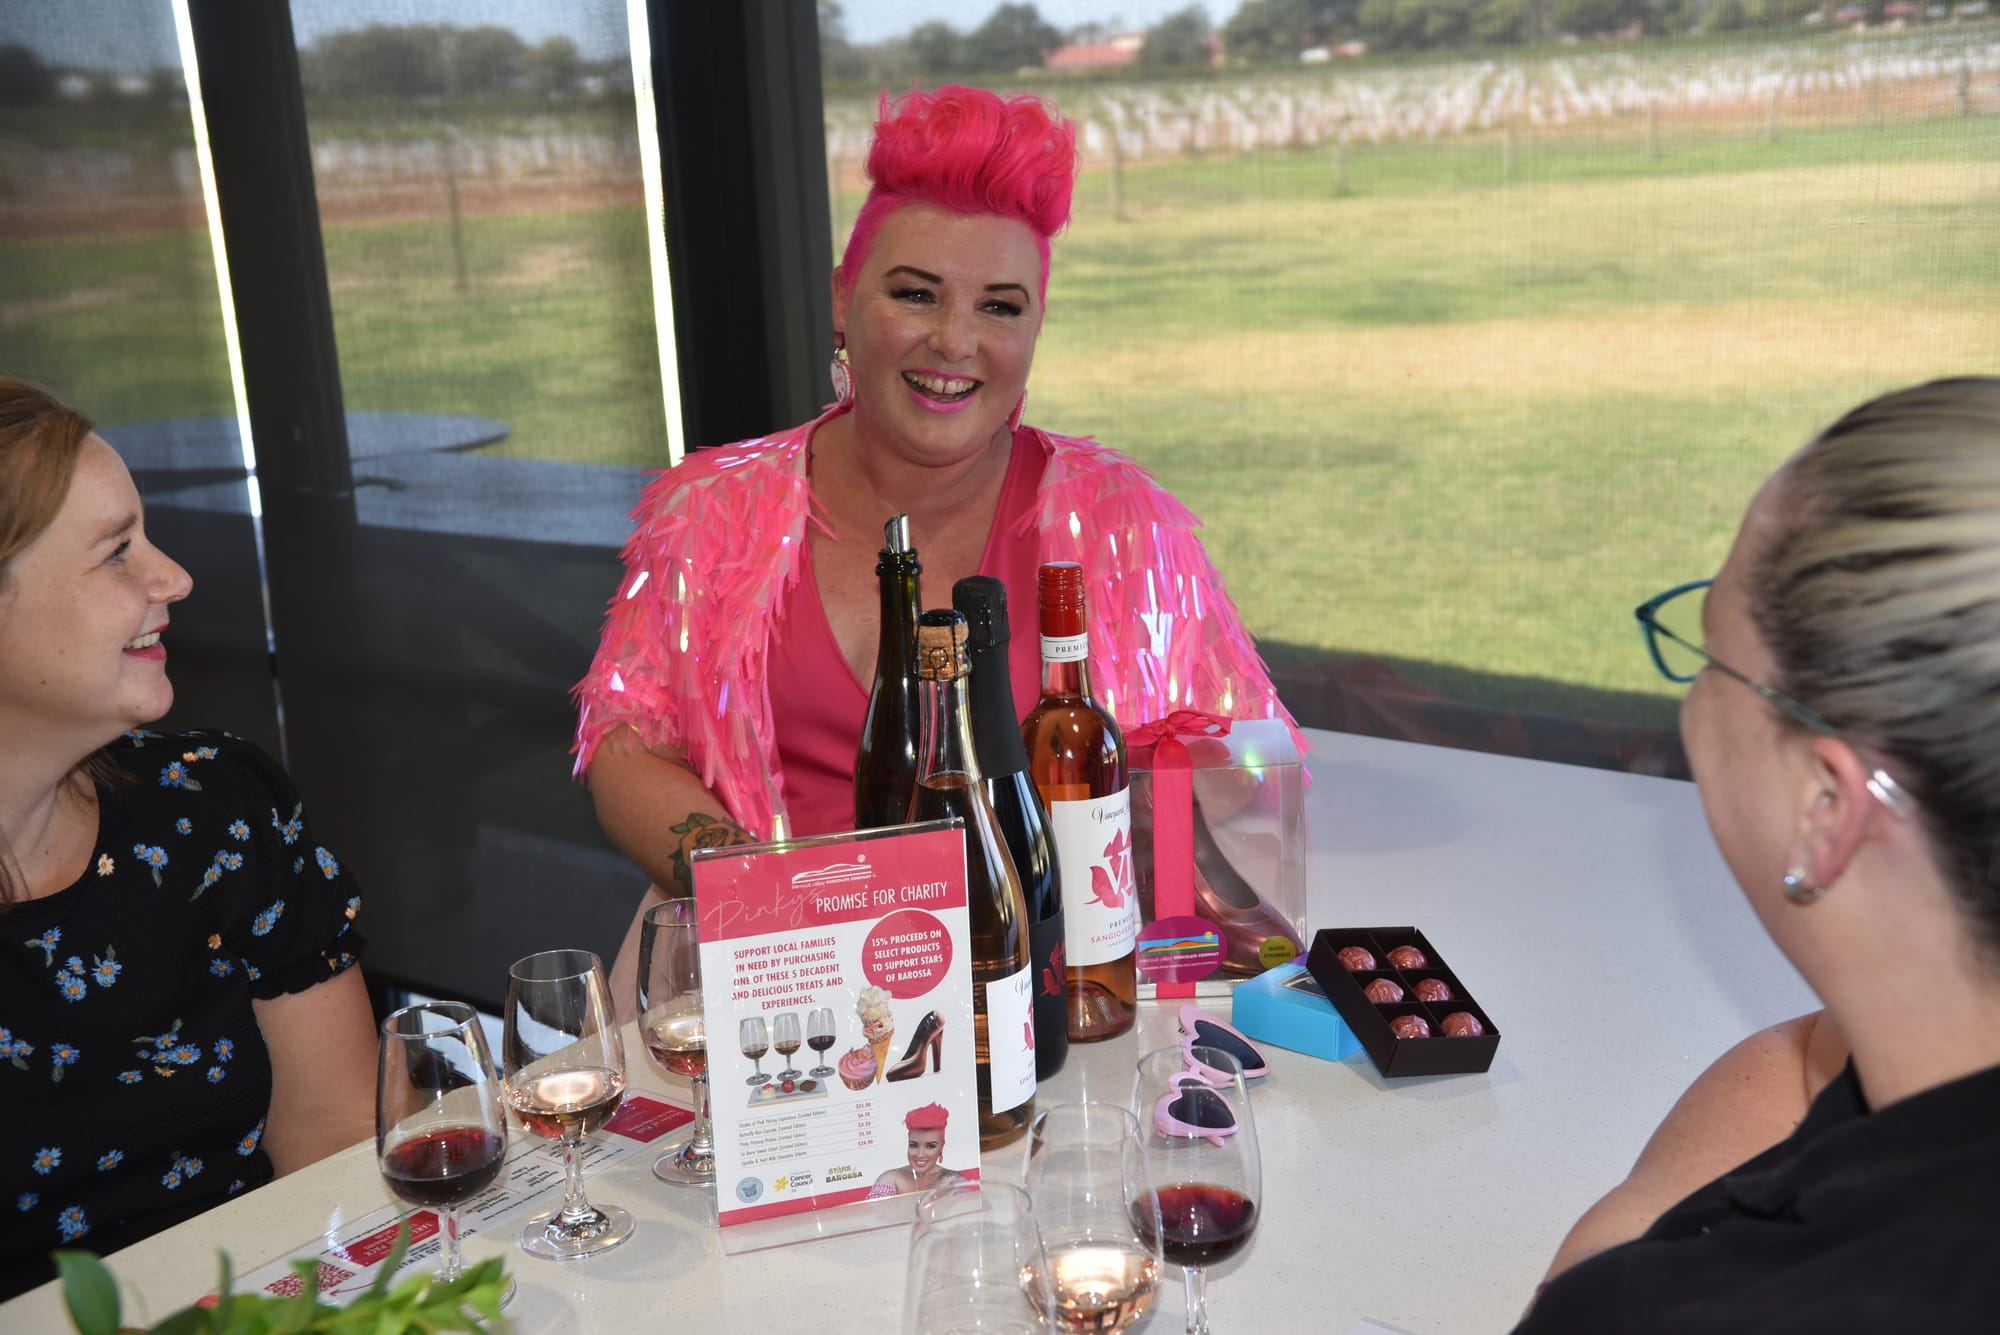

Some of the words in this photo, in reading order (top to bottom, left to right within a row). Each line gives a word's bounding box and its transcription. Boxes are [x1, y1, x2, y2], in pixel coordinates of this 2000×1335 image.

[816, 892, 868, 914] PROMISE
[874, 889, 896, 904] FOR
[900, 881, 948, 902] CHARITY
[872, 936, 888, 948] 15%
[890, 931, 928, 944] PROCEEDS
[930, 929, 942, 938] ON
[734, 946, 771, 960] SUPPORT
[774, 942, 798, 954] LOCAL
[801, 936, 836, 949] FAMILIES
[874, 948, 899, 960] SELECT
[901, 942, 940, 956] PRODUCTS
[736, 964, 744, 973] IN
[748, 961, 768, 971] NEED
[771, 958, 780, 968] BY
[784, 950, 836, 966] PURCHASING
[872, 963, 882, 972] TO
[885, 958, 918, 970] SUPPORT
[921, 954, 943, 965] STARS
[734, 977, 750, 986] ONE
[753, 975, 764, 984] OF
[766, 971, 789, 982] THESE
[792, 970, 797, 978] 5
[800, 964, 840, 977] DECADENT
[886, 974, 896, 982] OF
[898, 968, 932, 980] BAROSSA
[732, 991, 749, 1000] AND
[752, 984, 794, 998] DELICIOUS
[796, 980, 824, 991] TREATS
[826, 976, 844, 987] AND
[762, 995, 816, 1010] EXPERIENCES.
[790, 1178, 813, 1188] Council
[826, 1172, 862, 1183] BAROSSA
